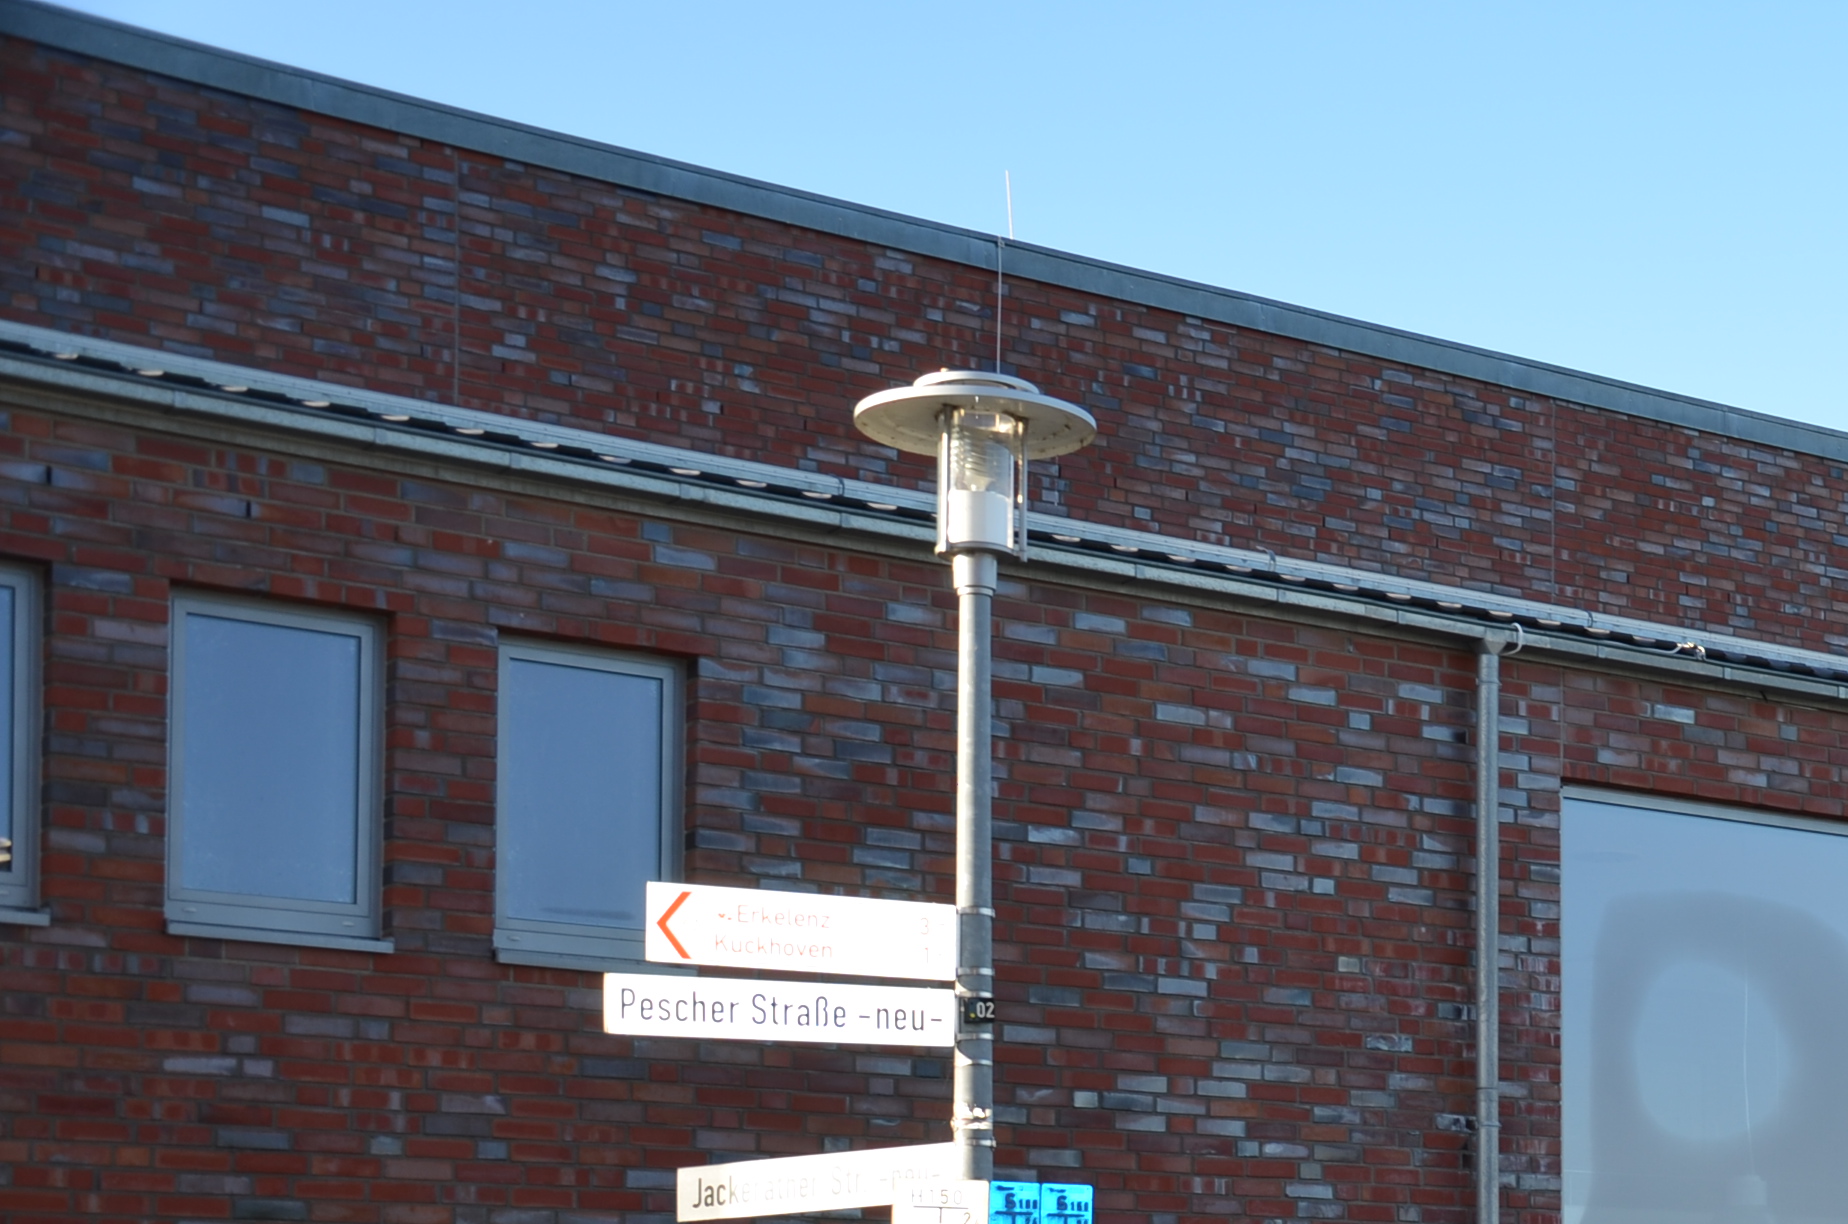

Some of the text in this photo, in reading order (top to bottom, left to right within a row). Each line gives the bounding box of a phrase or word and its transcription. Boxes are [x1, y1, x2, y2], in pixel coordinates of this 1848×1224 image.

[737, 904, 830, 929] Erkelenz
[621, 988, 943, 1031] Pescher Straße -neu-
[976, 1001, 996, 1019] 02
